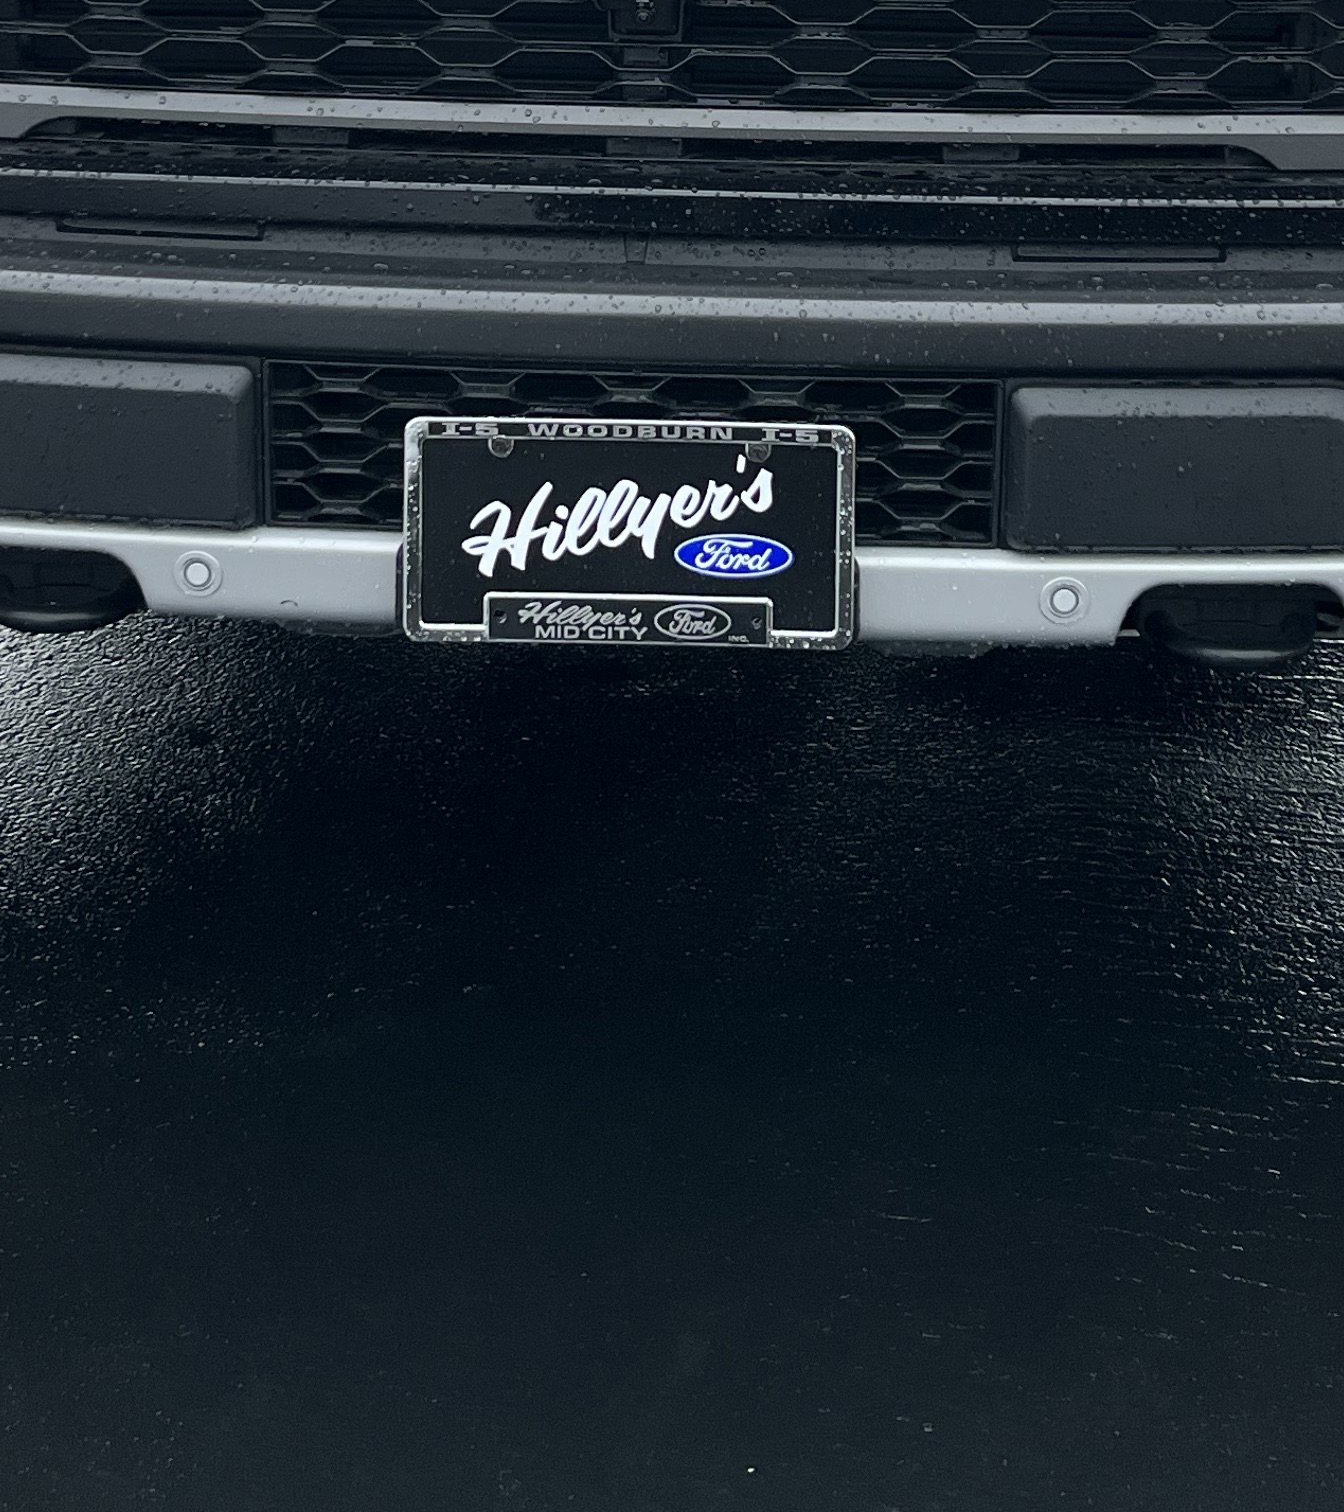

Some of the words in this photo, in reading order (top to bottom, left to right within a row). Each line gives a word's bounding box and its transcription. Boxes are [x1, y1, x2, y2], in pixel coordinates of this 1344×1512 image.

[441, 421, 499, 435] I-5
[527, 423, 734, 441] WOODBURN
[761, 428, 820, 444] I-5
[461, 452, 775, 578] Hillyer's
[694, 537, 771, 572] Ford
[517, 600, 643, 630] Hillyer's
[668, 608, 717, 635] Ford
[534, 624, 581, 639] MID
[587, 626, 649, 641] CITY
